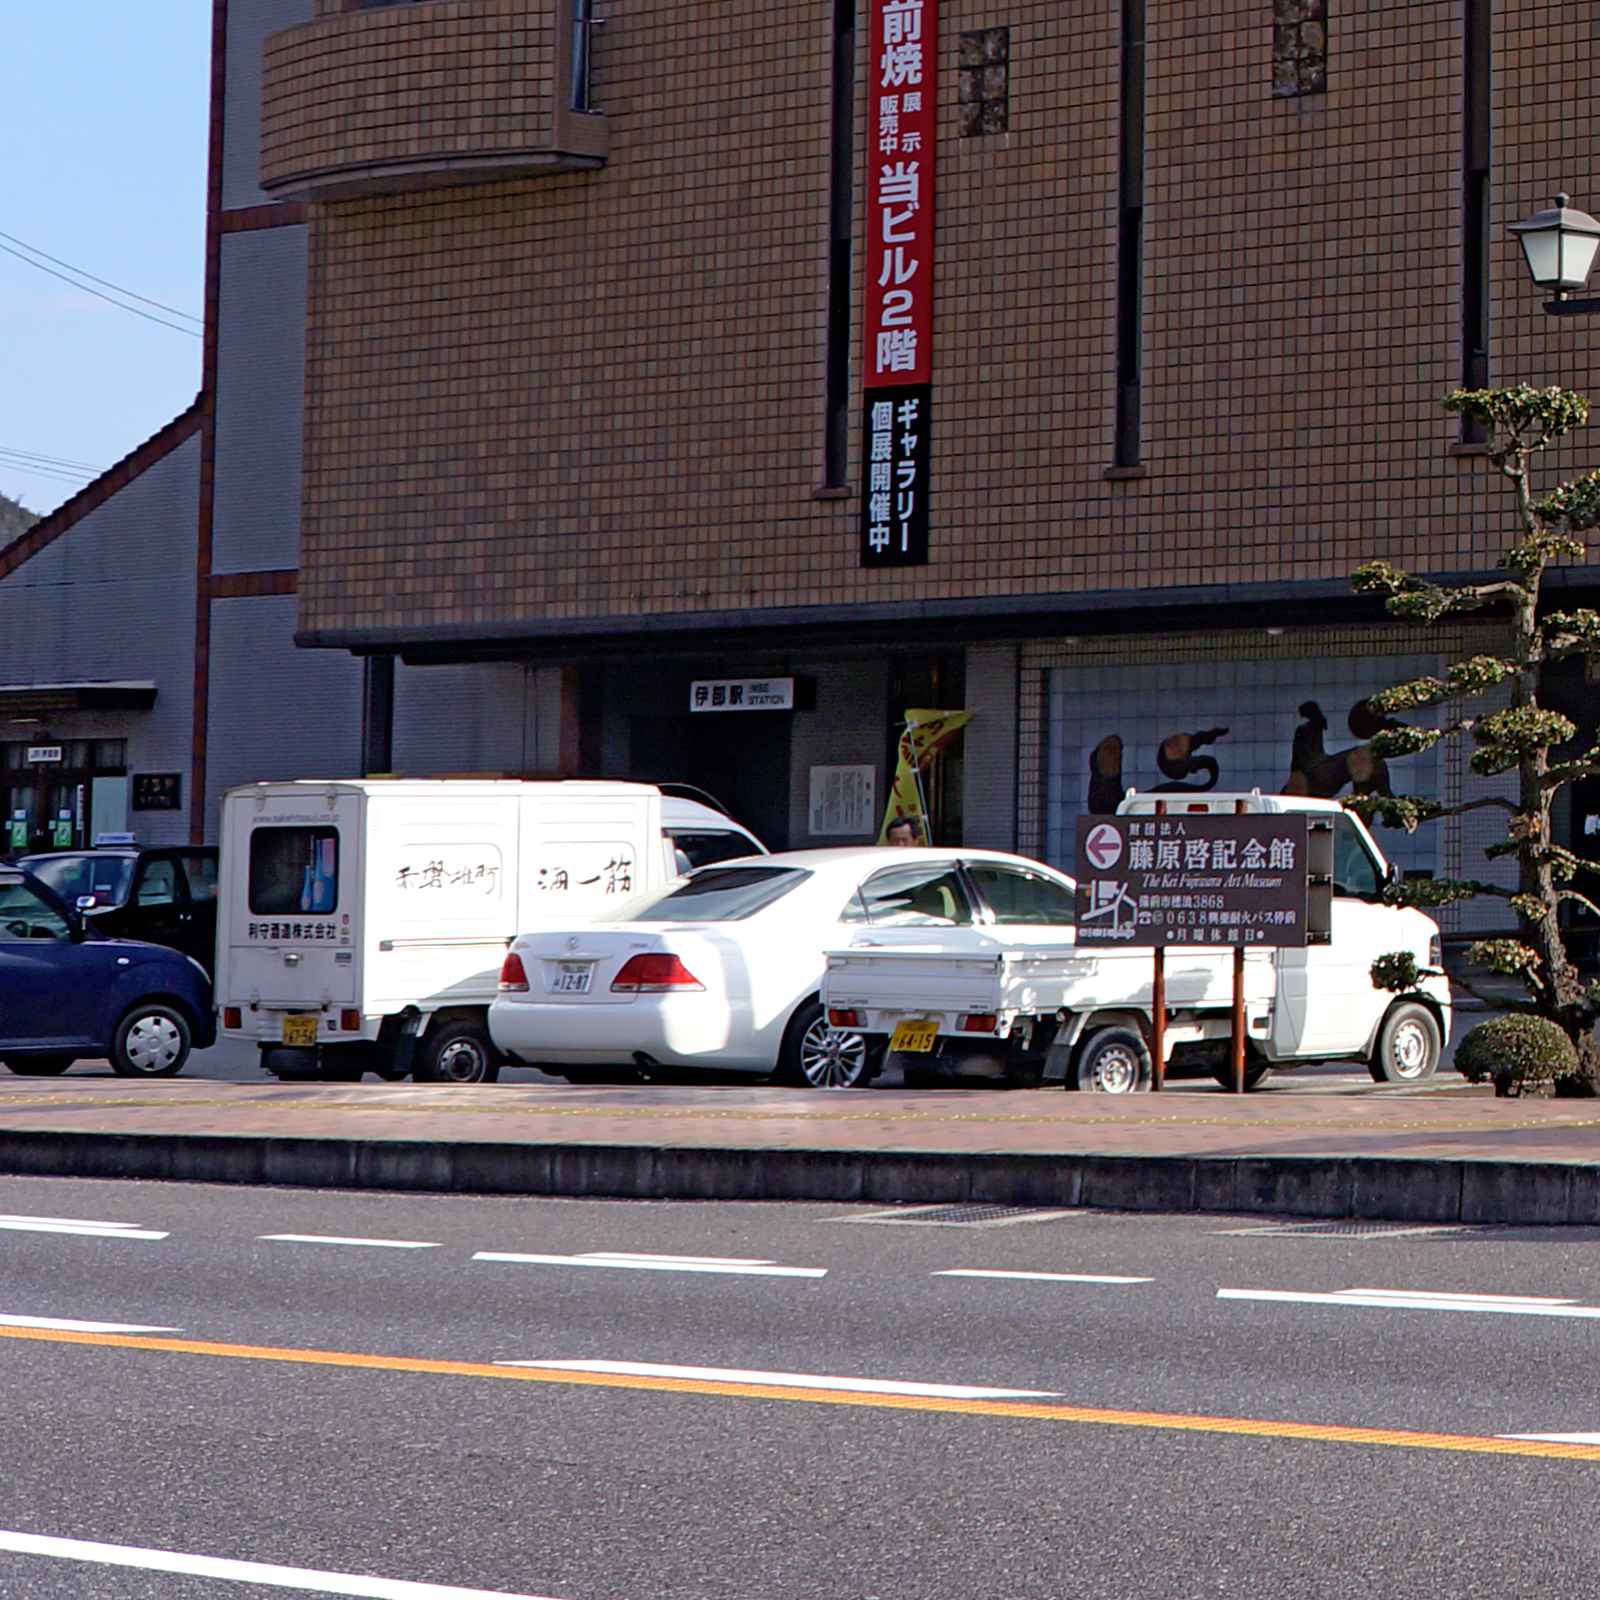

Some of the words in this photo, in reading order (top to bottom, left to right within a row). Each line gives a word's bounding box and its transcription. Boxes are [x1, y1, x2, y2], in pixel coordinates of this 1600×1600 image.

[879, 94, 899, 156] 販売中
[876, 161, 921, 373] 当ビル2階
[869, 401, 893, 553] 個展開催中
[896, 398, 919, 552] ギャラリー
[1128, 838, 1296, 870] 藤原啓記念館
[1129, 823, 1187, 836] 財団法人
[1142, 873, 1160, 887] The
[1161, 873, 1178, 887] Kei
[1223, 873, 1242, 887] Art
[1241, 873, 1282, 887] Museum
